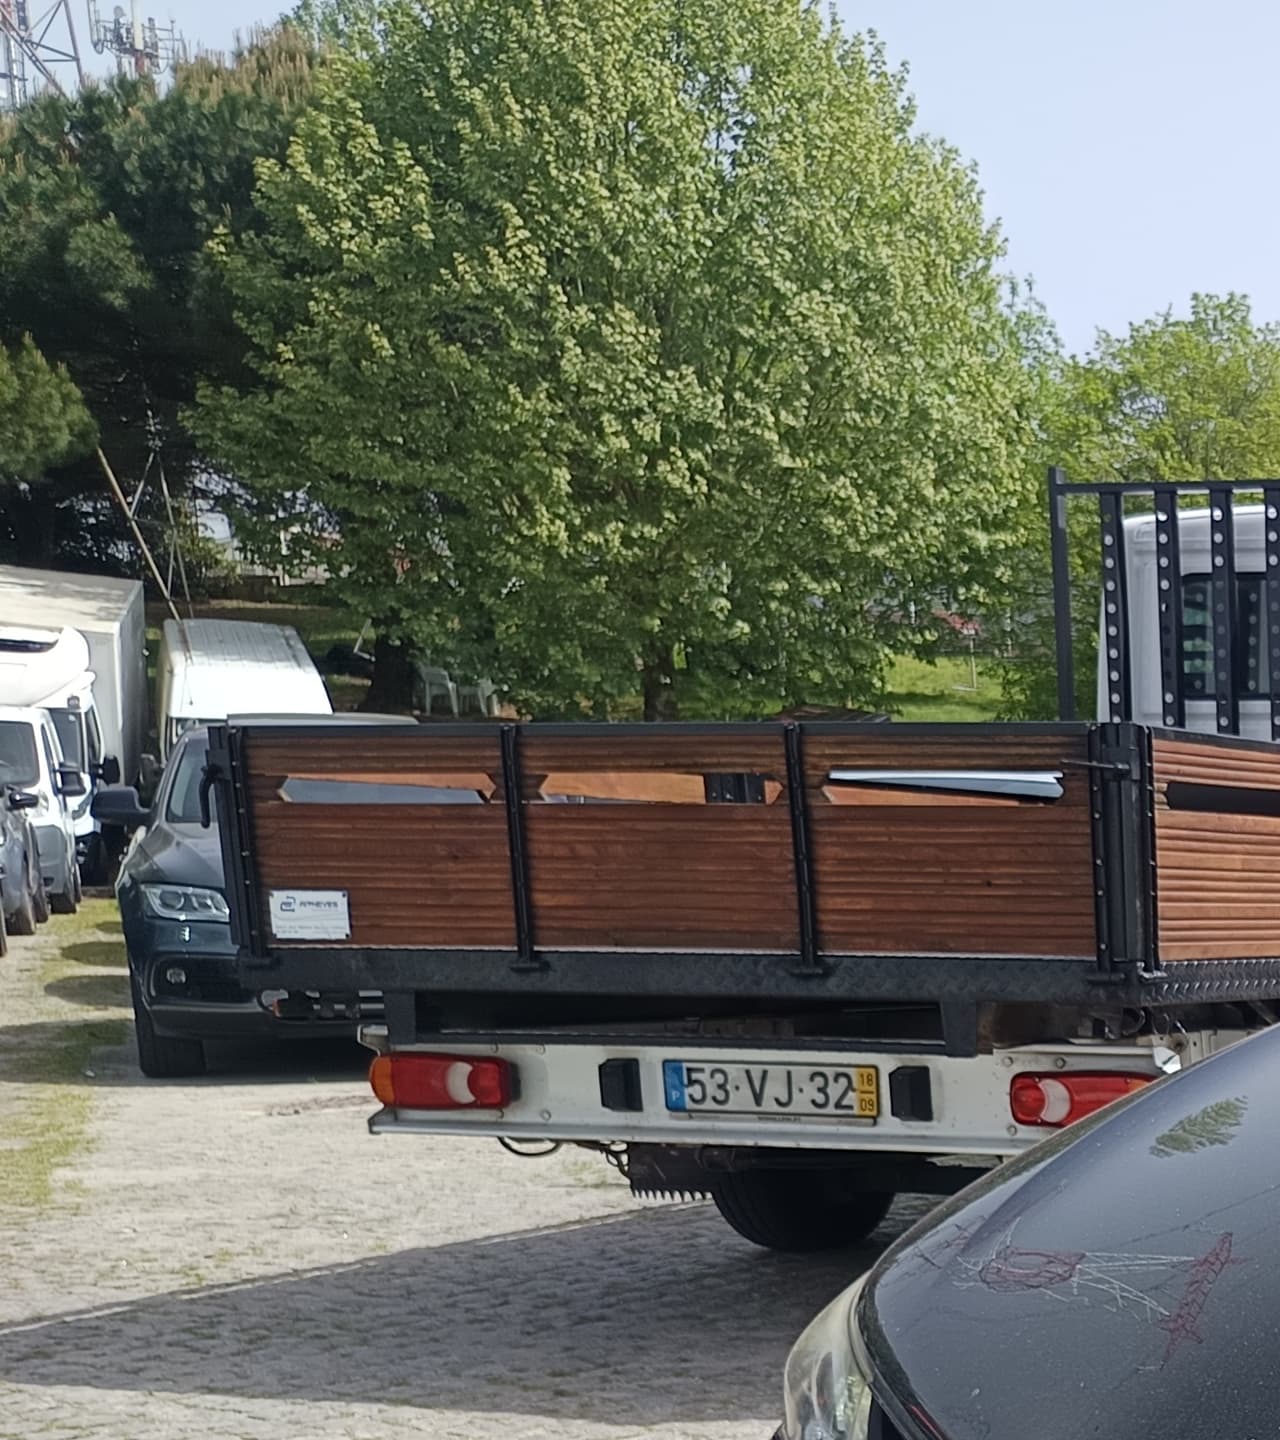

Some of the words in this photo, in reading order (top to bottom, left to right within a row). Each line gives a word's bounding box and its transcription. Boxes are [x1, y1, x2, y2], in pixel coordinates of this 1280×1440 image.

[859, 1073, 873, 1088] 18
[671, 1091, 681, 1101] P
[859, 1099, 875, 1112] 09
